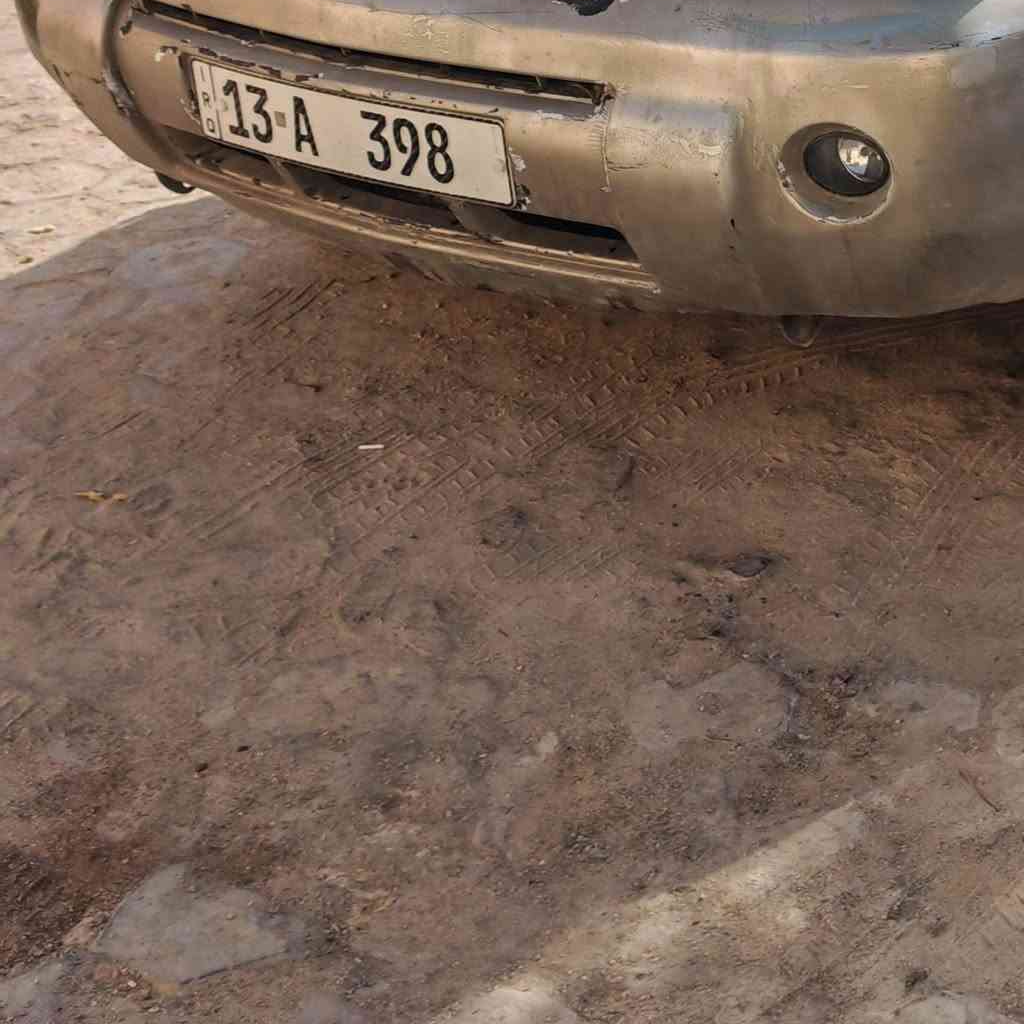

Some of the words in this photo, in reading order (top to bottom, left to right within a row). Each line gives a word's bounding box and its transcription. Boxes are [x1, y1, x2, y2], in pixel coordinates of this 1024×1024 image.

[222, 79, 273, 144] 13
[293, 96, 319, 157] A
[360, 110, 455, 184] 398
